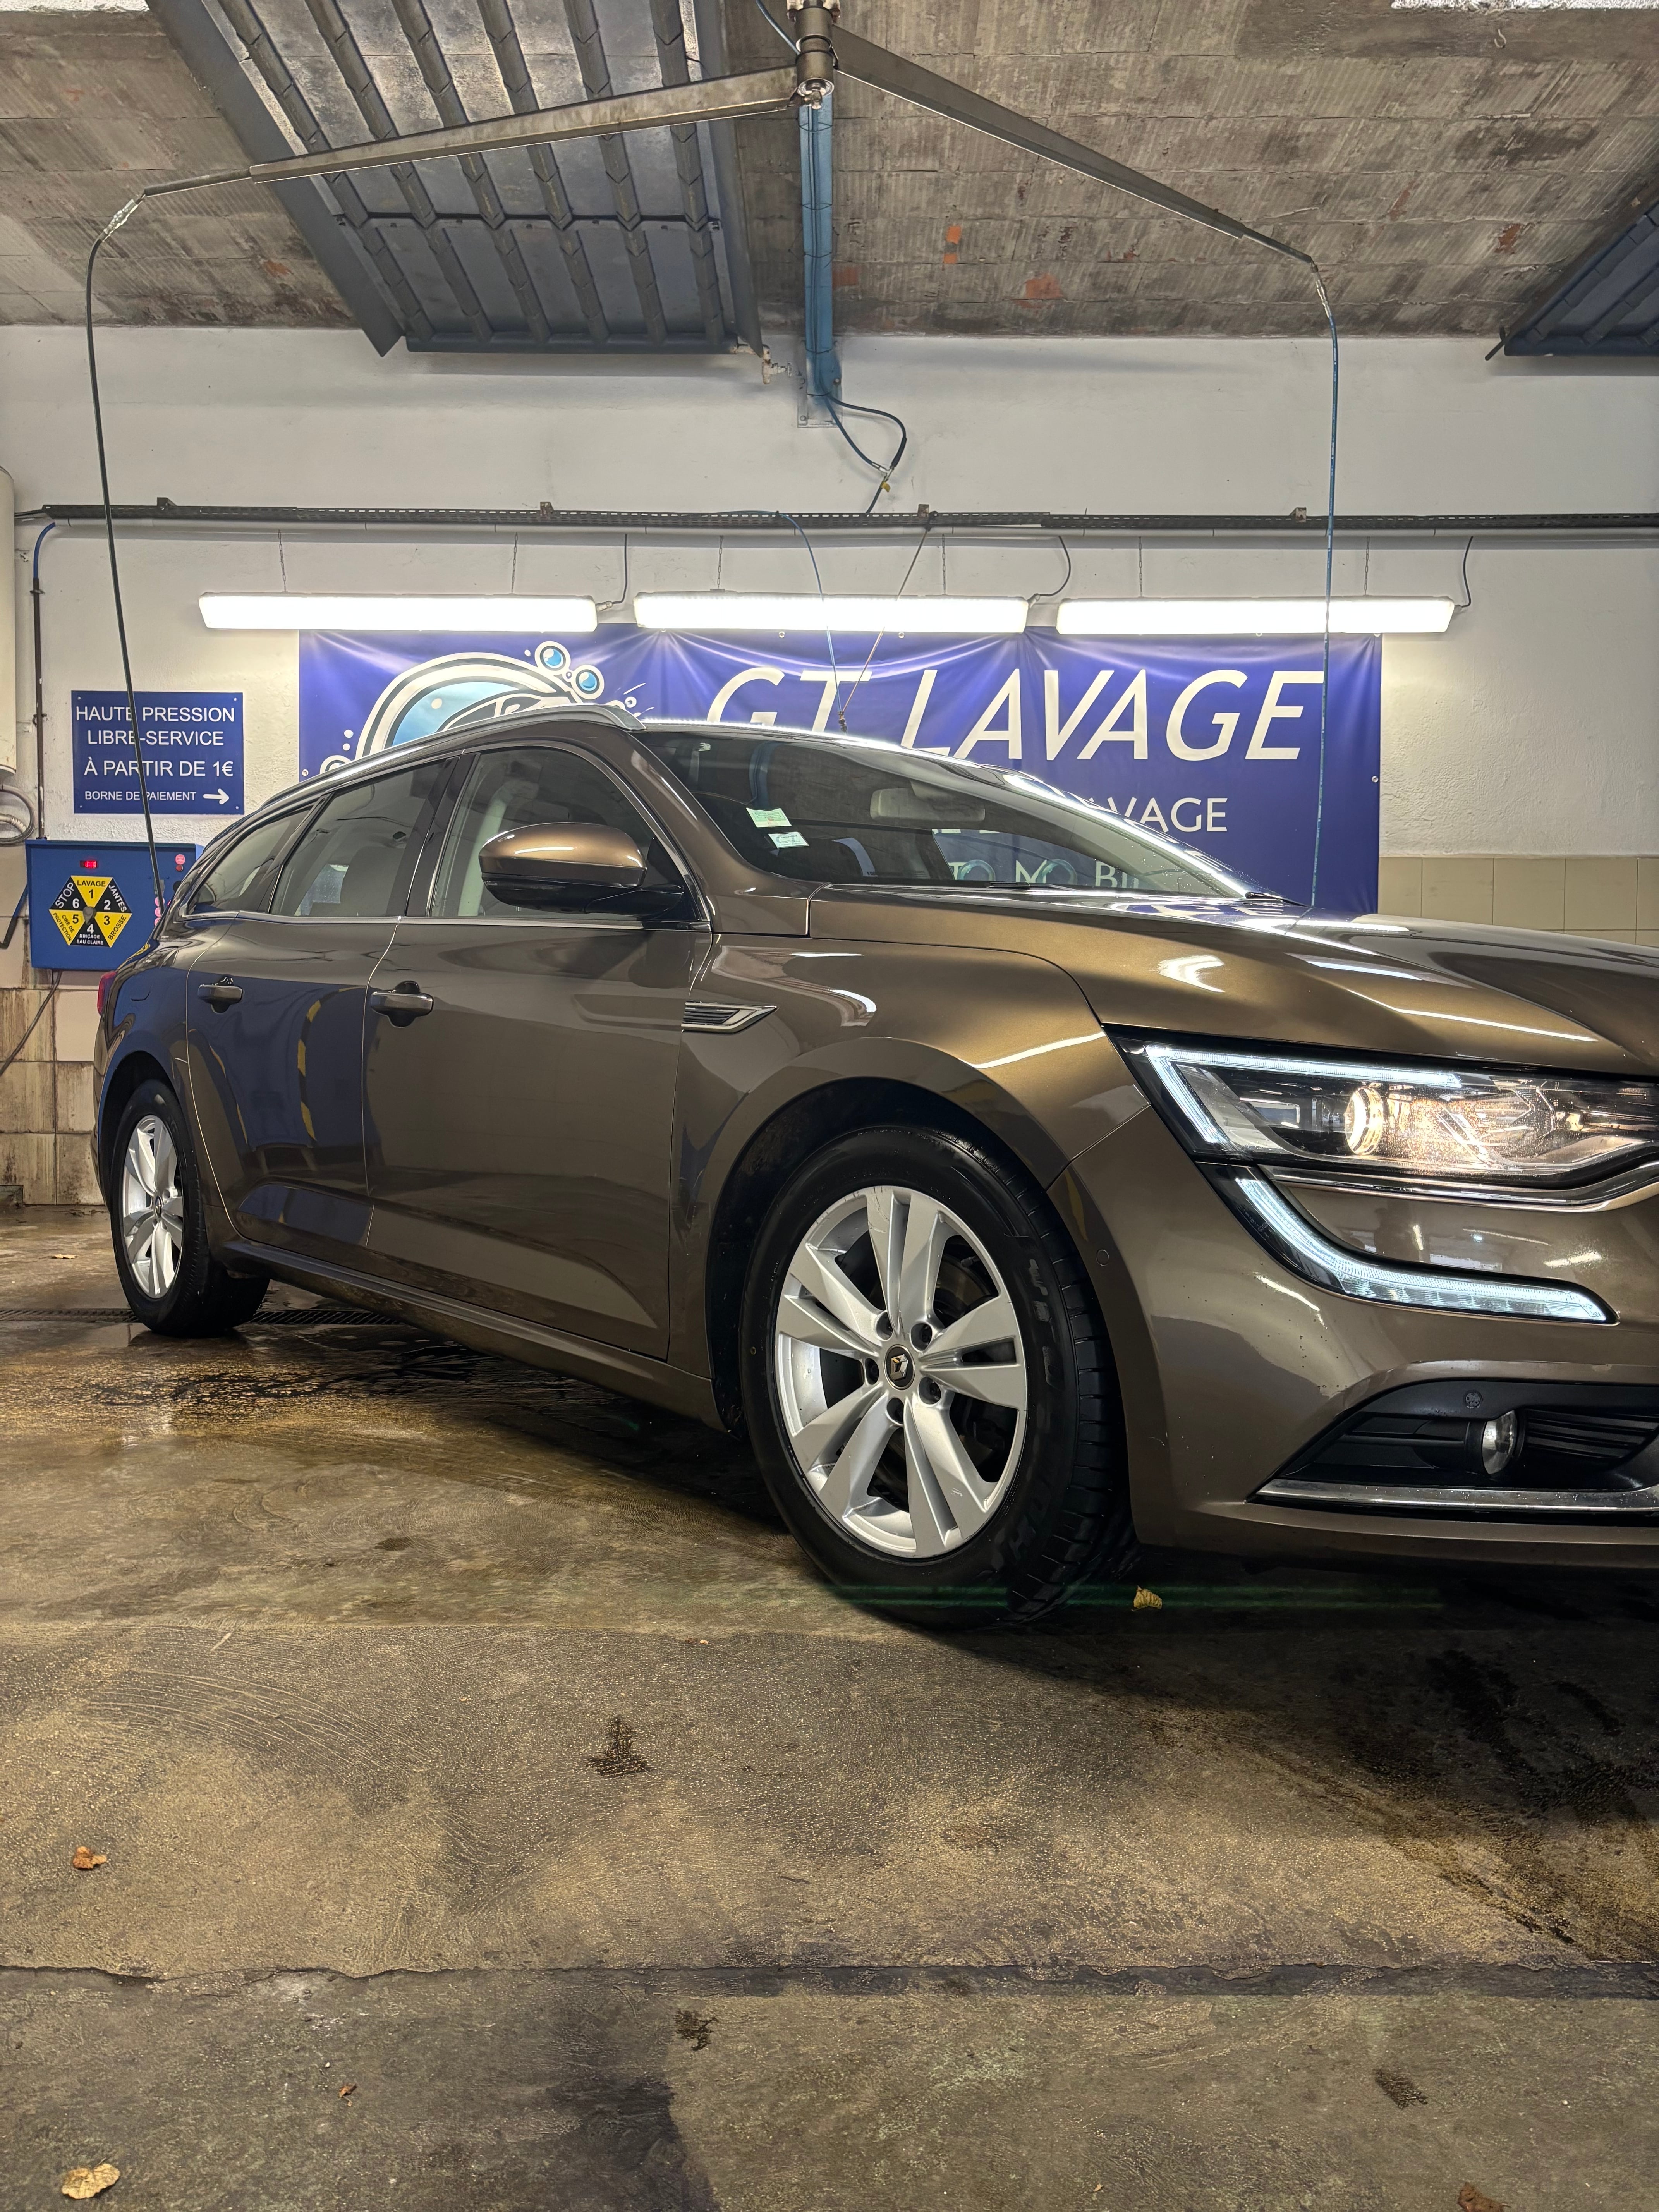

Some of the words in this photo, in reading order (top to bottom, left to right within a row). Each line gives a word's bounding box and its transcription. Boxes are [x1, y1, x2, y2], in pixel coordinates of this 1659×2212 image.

[76, 706, 131, 721] HAUTE
[143, 707, 234, 722] PRESSION
[900, 669, 1324, 761] LAVAGE
[88, 730, 224, 745] LIBRE-SERVICE
[84, 757, 98, 776] À
[104, 760, 173, 776] PARTIR
[180, 761, 206, 776] DE
[213, 761, 234, 776] 1€
[85, 792, 122, 800] BORNE
[126, 792, 140, 800] DE
[55, 882, 74, 908] STOP
[89, 889, 94, 899] 1
[108, 884, 127, 912] JANTES
[72, 898, 80, 908] 6
[104, 900, 111, 910] 2
[62, 915, 70, 926] CIRE
[72, 914, 79, 924] 5
[103, 915, 110, 926] 3
[53, 912, 72, 941] PROTECTION
[87, 924, 94, 934] 4
[108, 915, 127, 940] BROSSE
